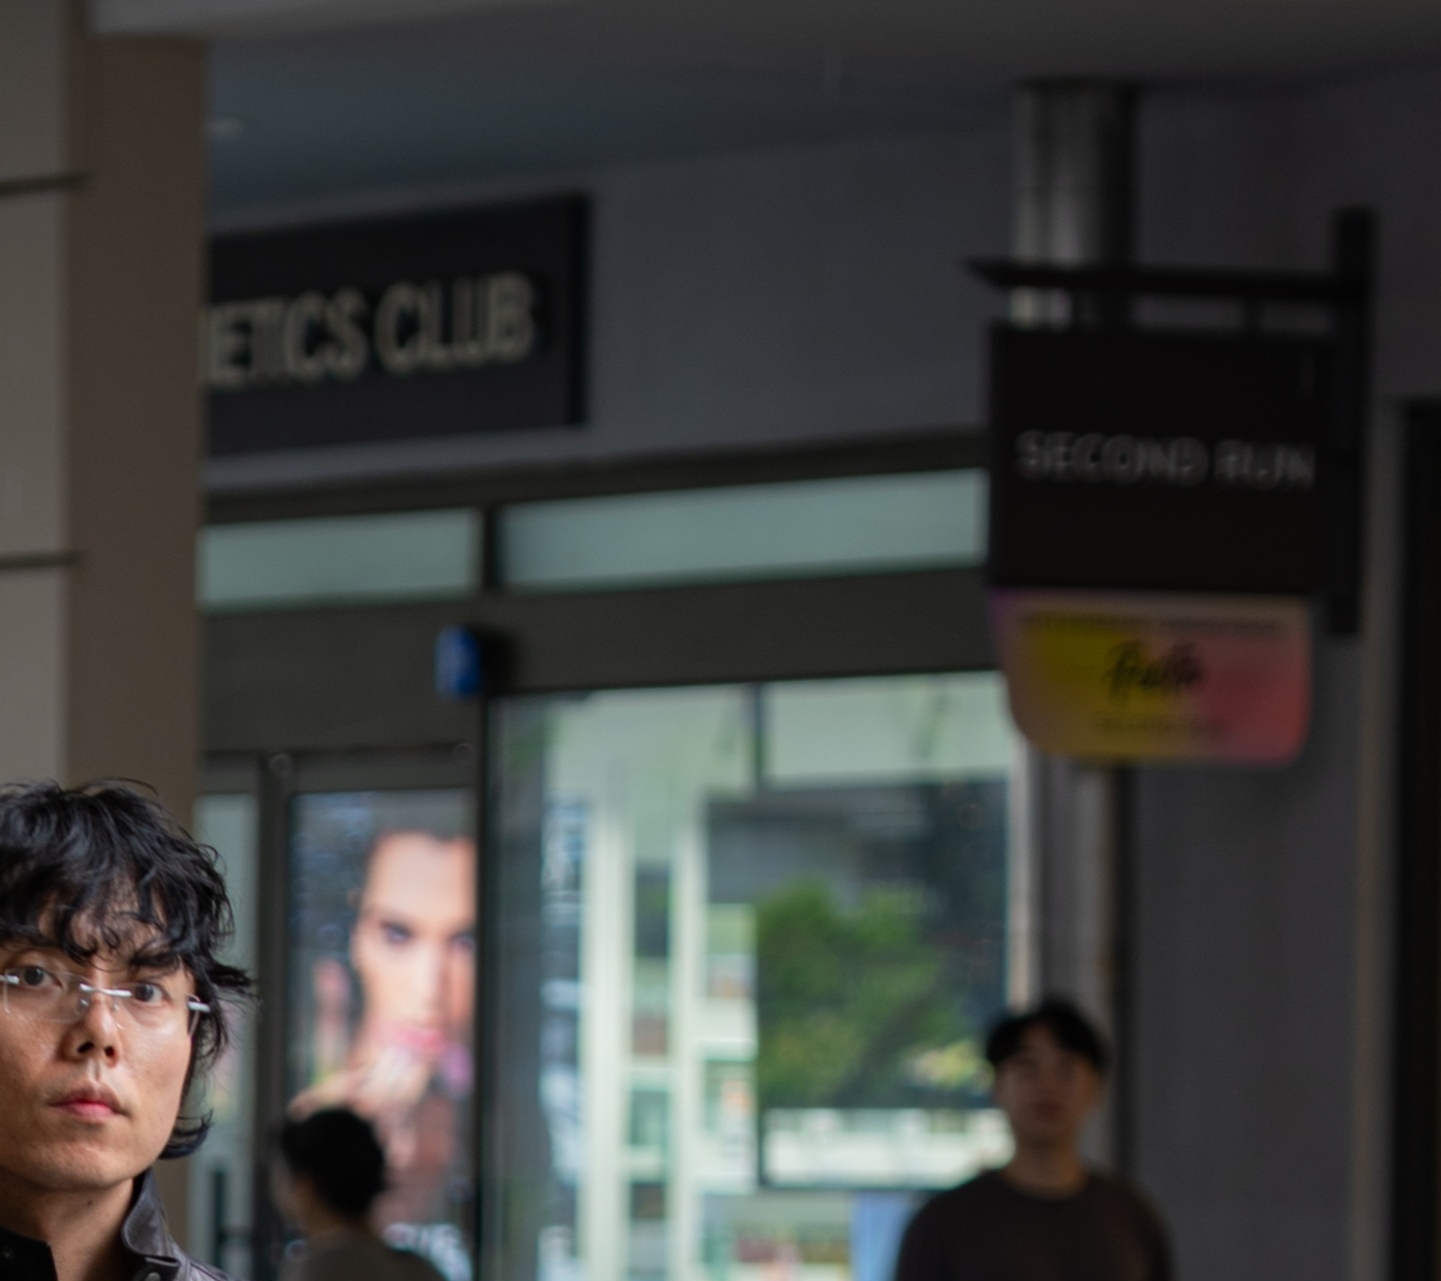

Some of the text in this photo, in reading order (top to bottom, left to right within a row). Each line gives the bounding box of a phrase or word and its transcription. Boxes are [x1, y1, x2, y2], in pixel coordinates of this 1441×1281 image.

[374, 271, 536, 376] CLUB
[1015, 430, 1317, 490] SECOND RUN
